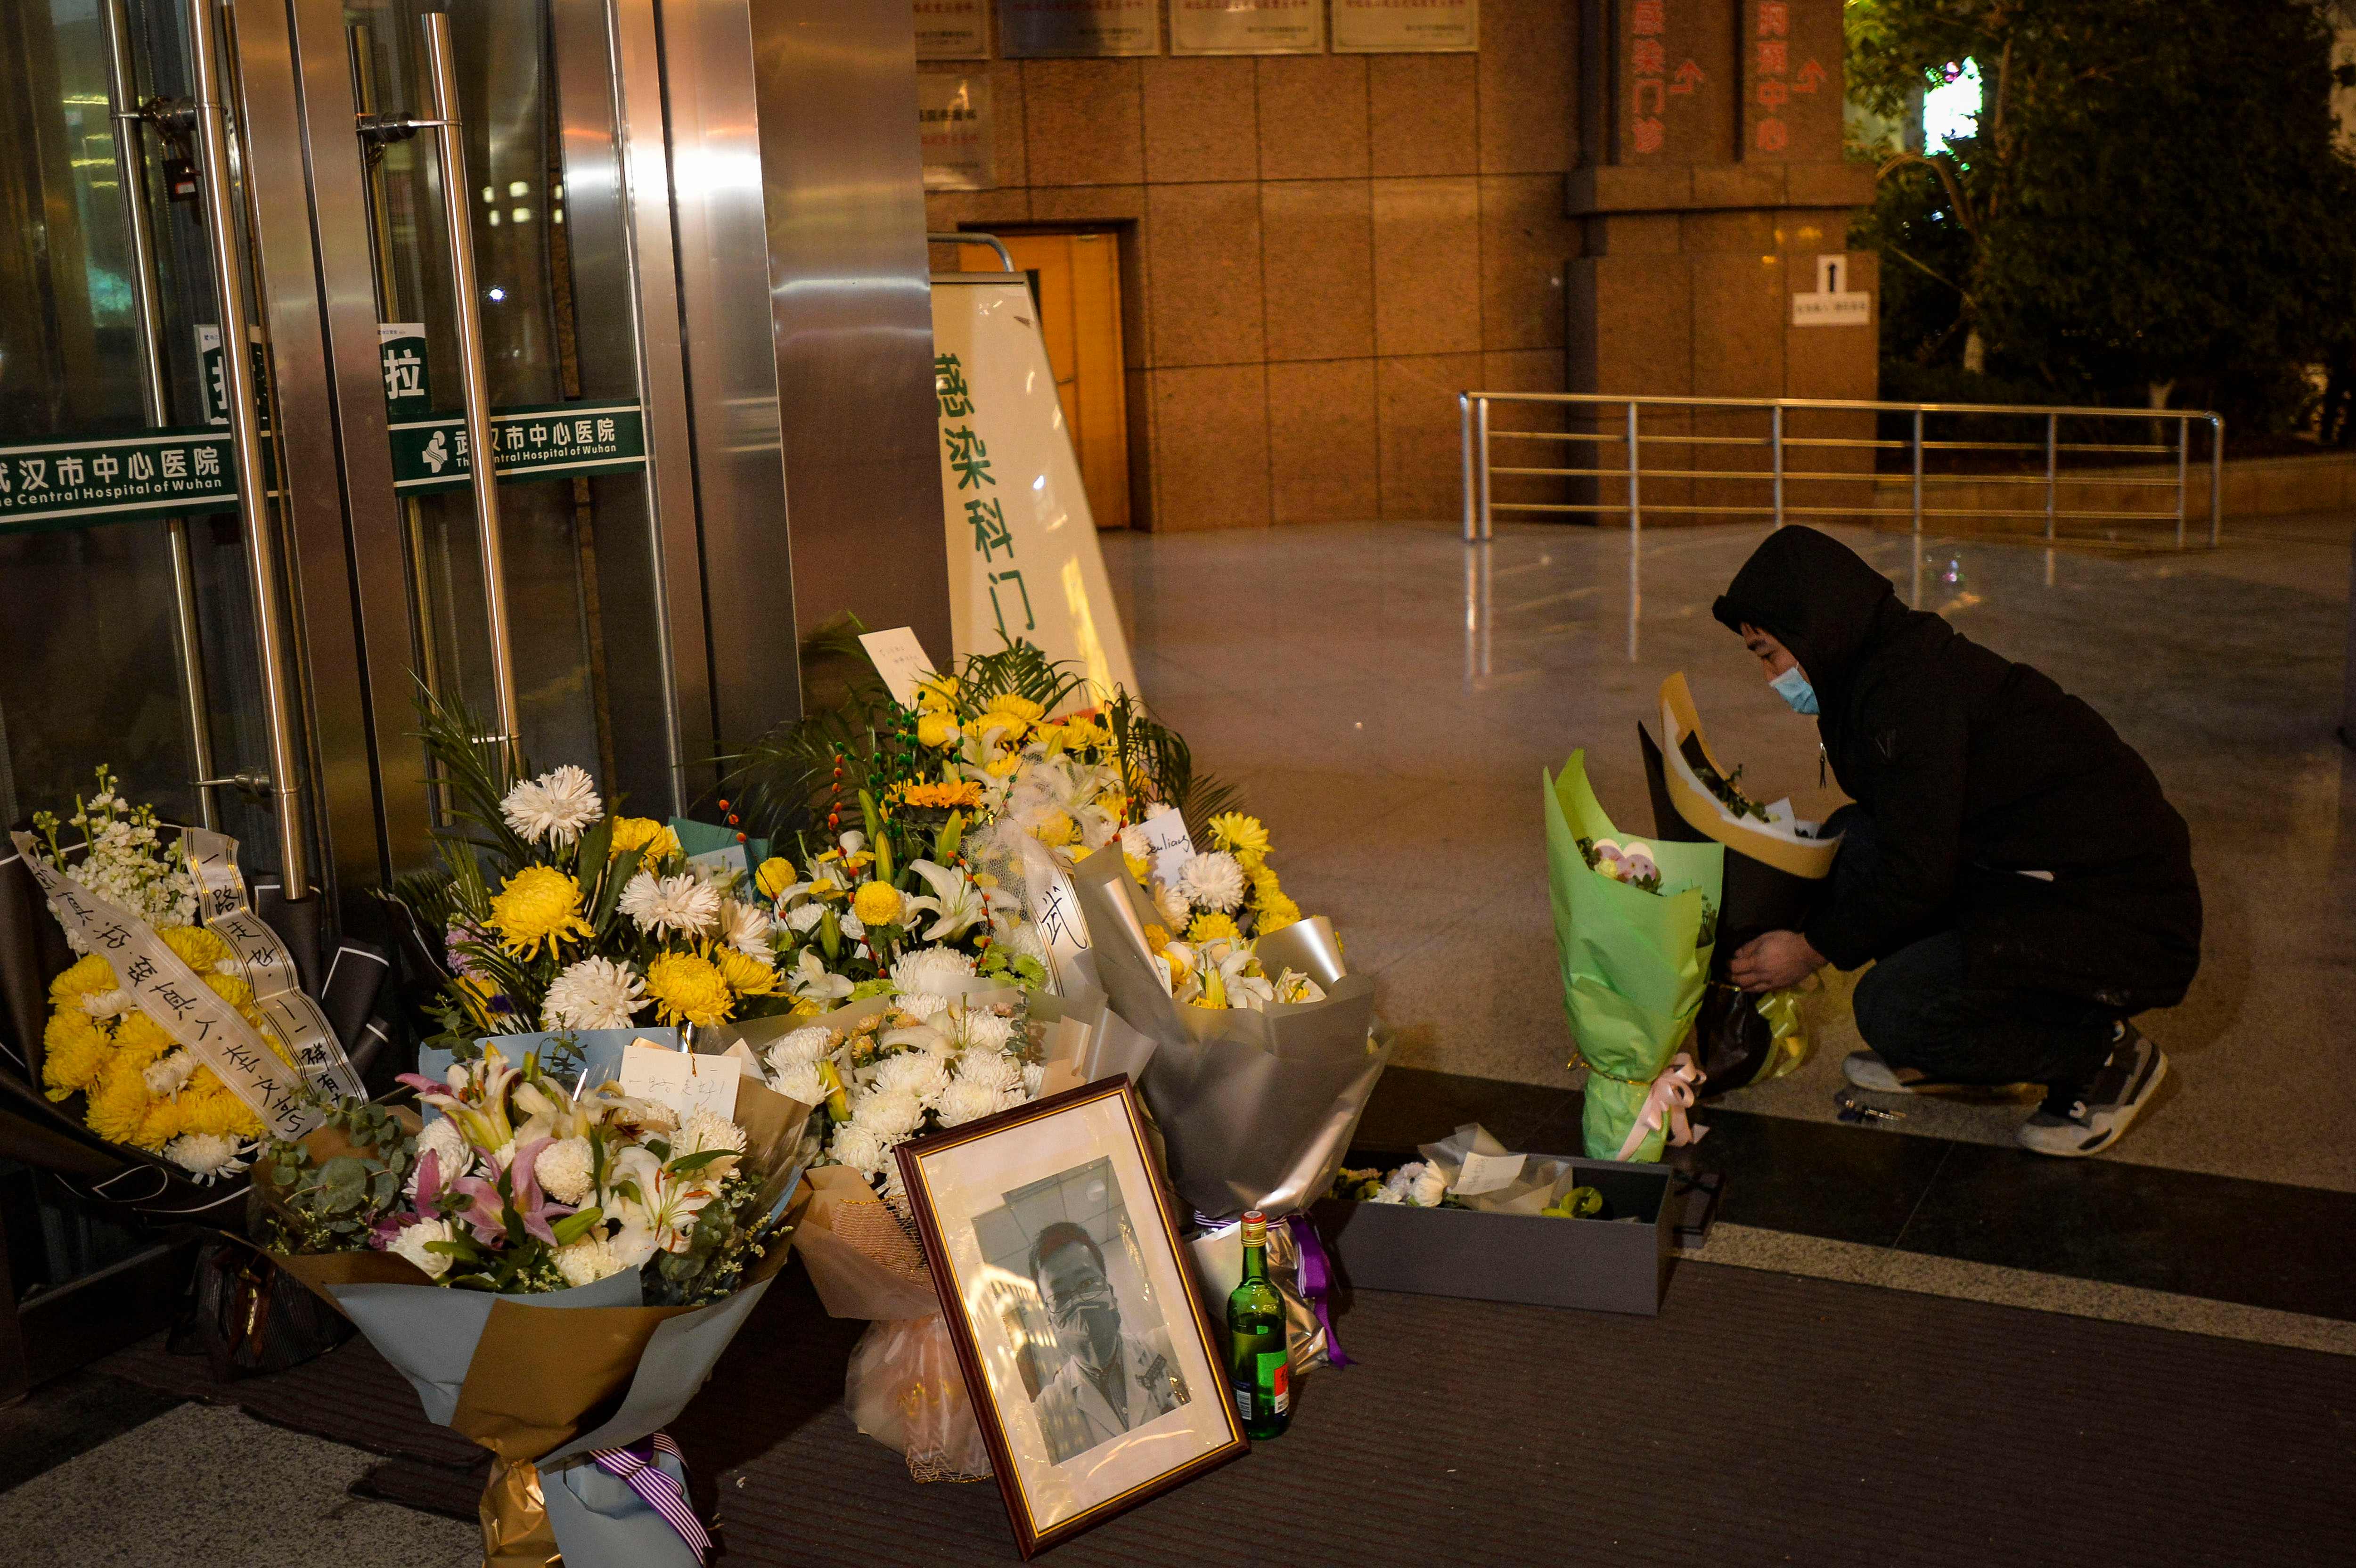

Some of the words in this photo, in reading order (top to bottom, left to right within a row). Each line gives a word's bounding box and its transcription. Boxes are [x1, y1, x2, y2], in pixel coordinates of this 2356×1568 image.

[383, 349, 425, 400] 拉
[523, 446, 568, 461] Hospital
[570, 446, 581, 456] of
[582, 444, 617, 455] Wuhan
[17, 488, 79, 505] Central
[83, 481, 150, 499] Hospital
[154, 481, 169, 493] of
[172, 478, 222, 491] Wuhan
[935, 353, 1046, 660] 感染科门
